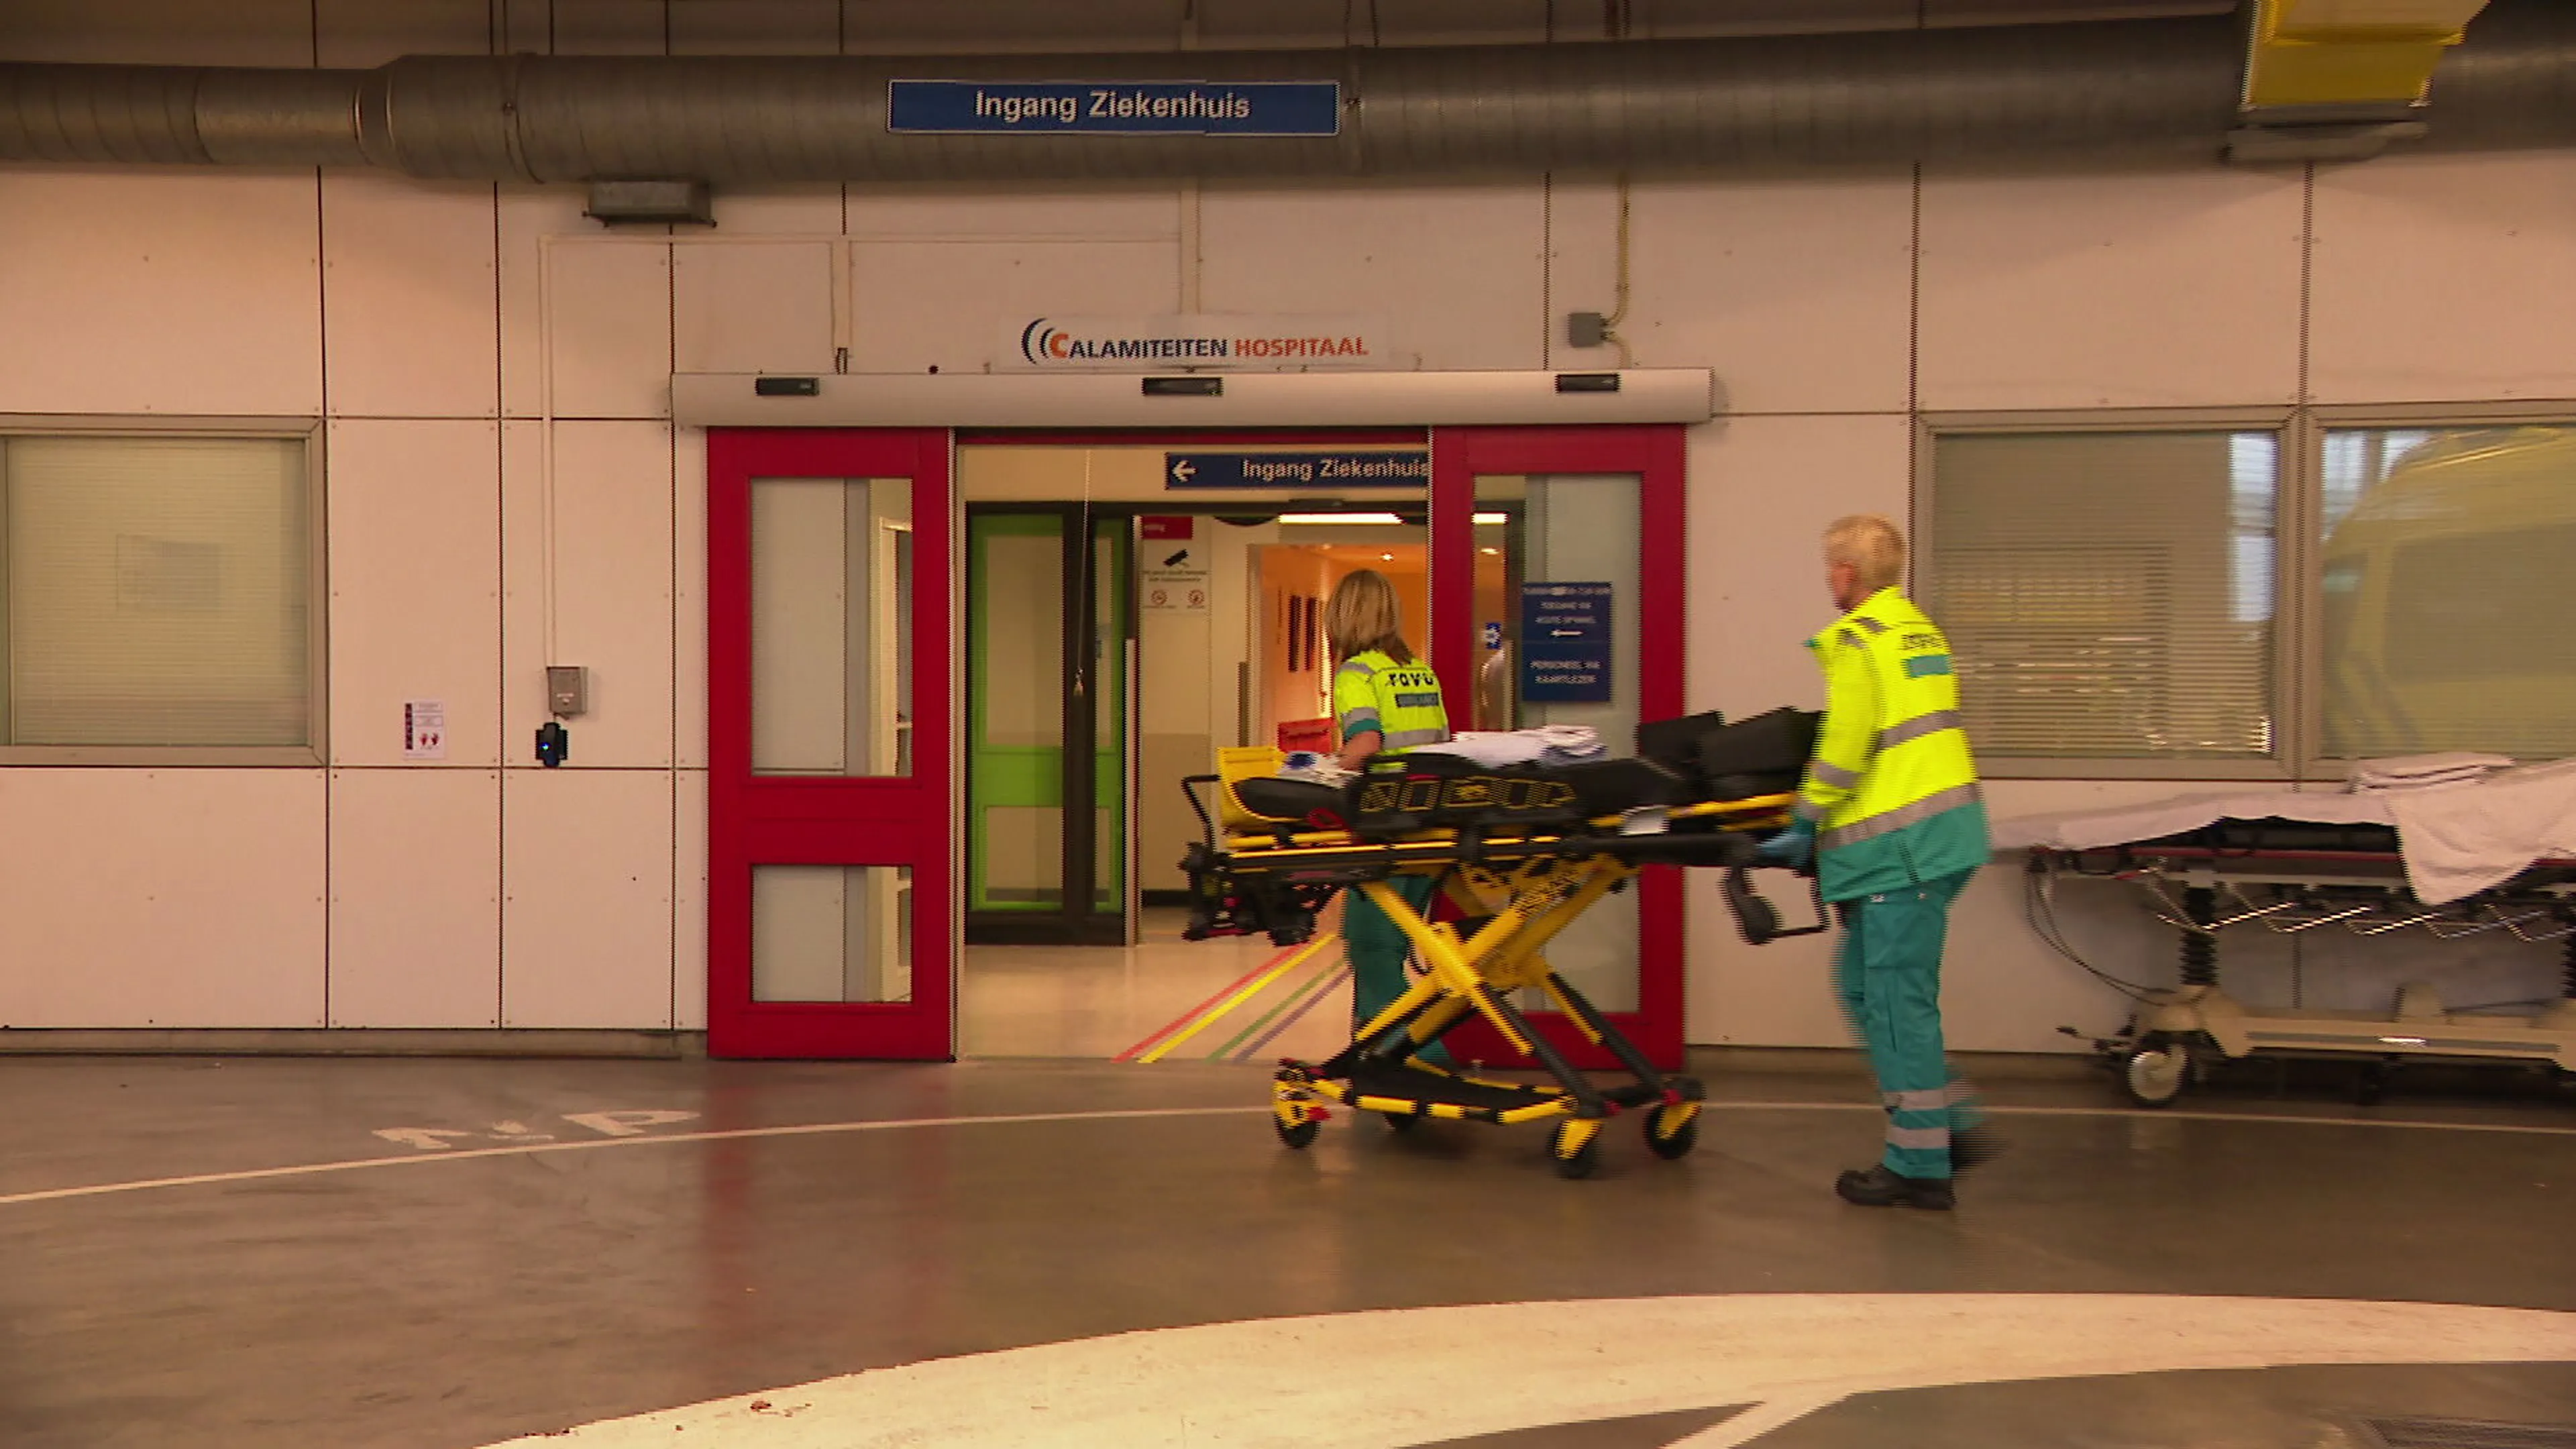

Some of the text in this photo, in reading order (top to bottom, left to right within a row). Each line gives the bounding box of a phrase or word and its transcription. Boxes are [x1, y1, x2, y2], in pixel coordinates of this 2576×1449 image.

[975, 90, 1252, 122] Ingang Ziekenhuis
[1049, 333, 1368, 359] CALAMITEITEN HOSPITAAL
[1242, 460, 1313, 481] Ingang
